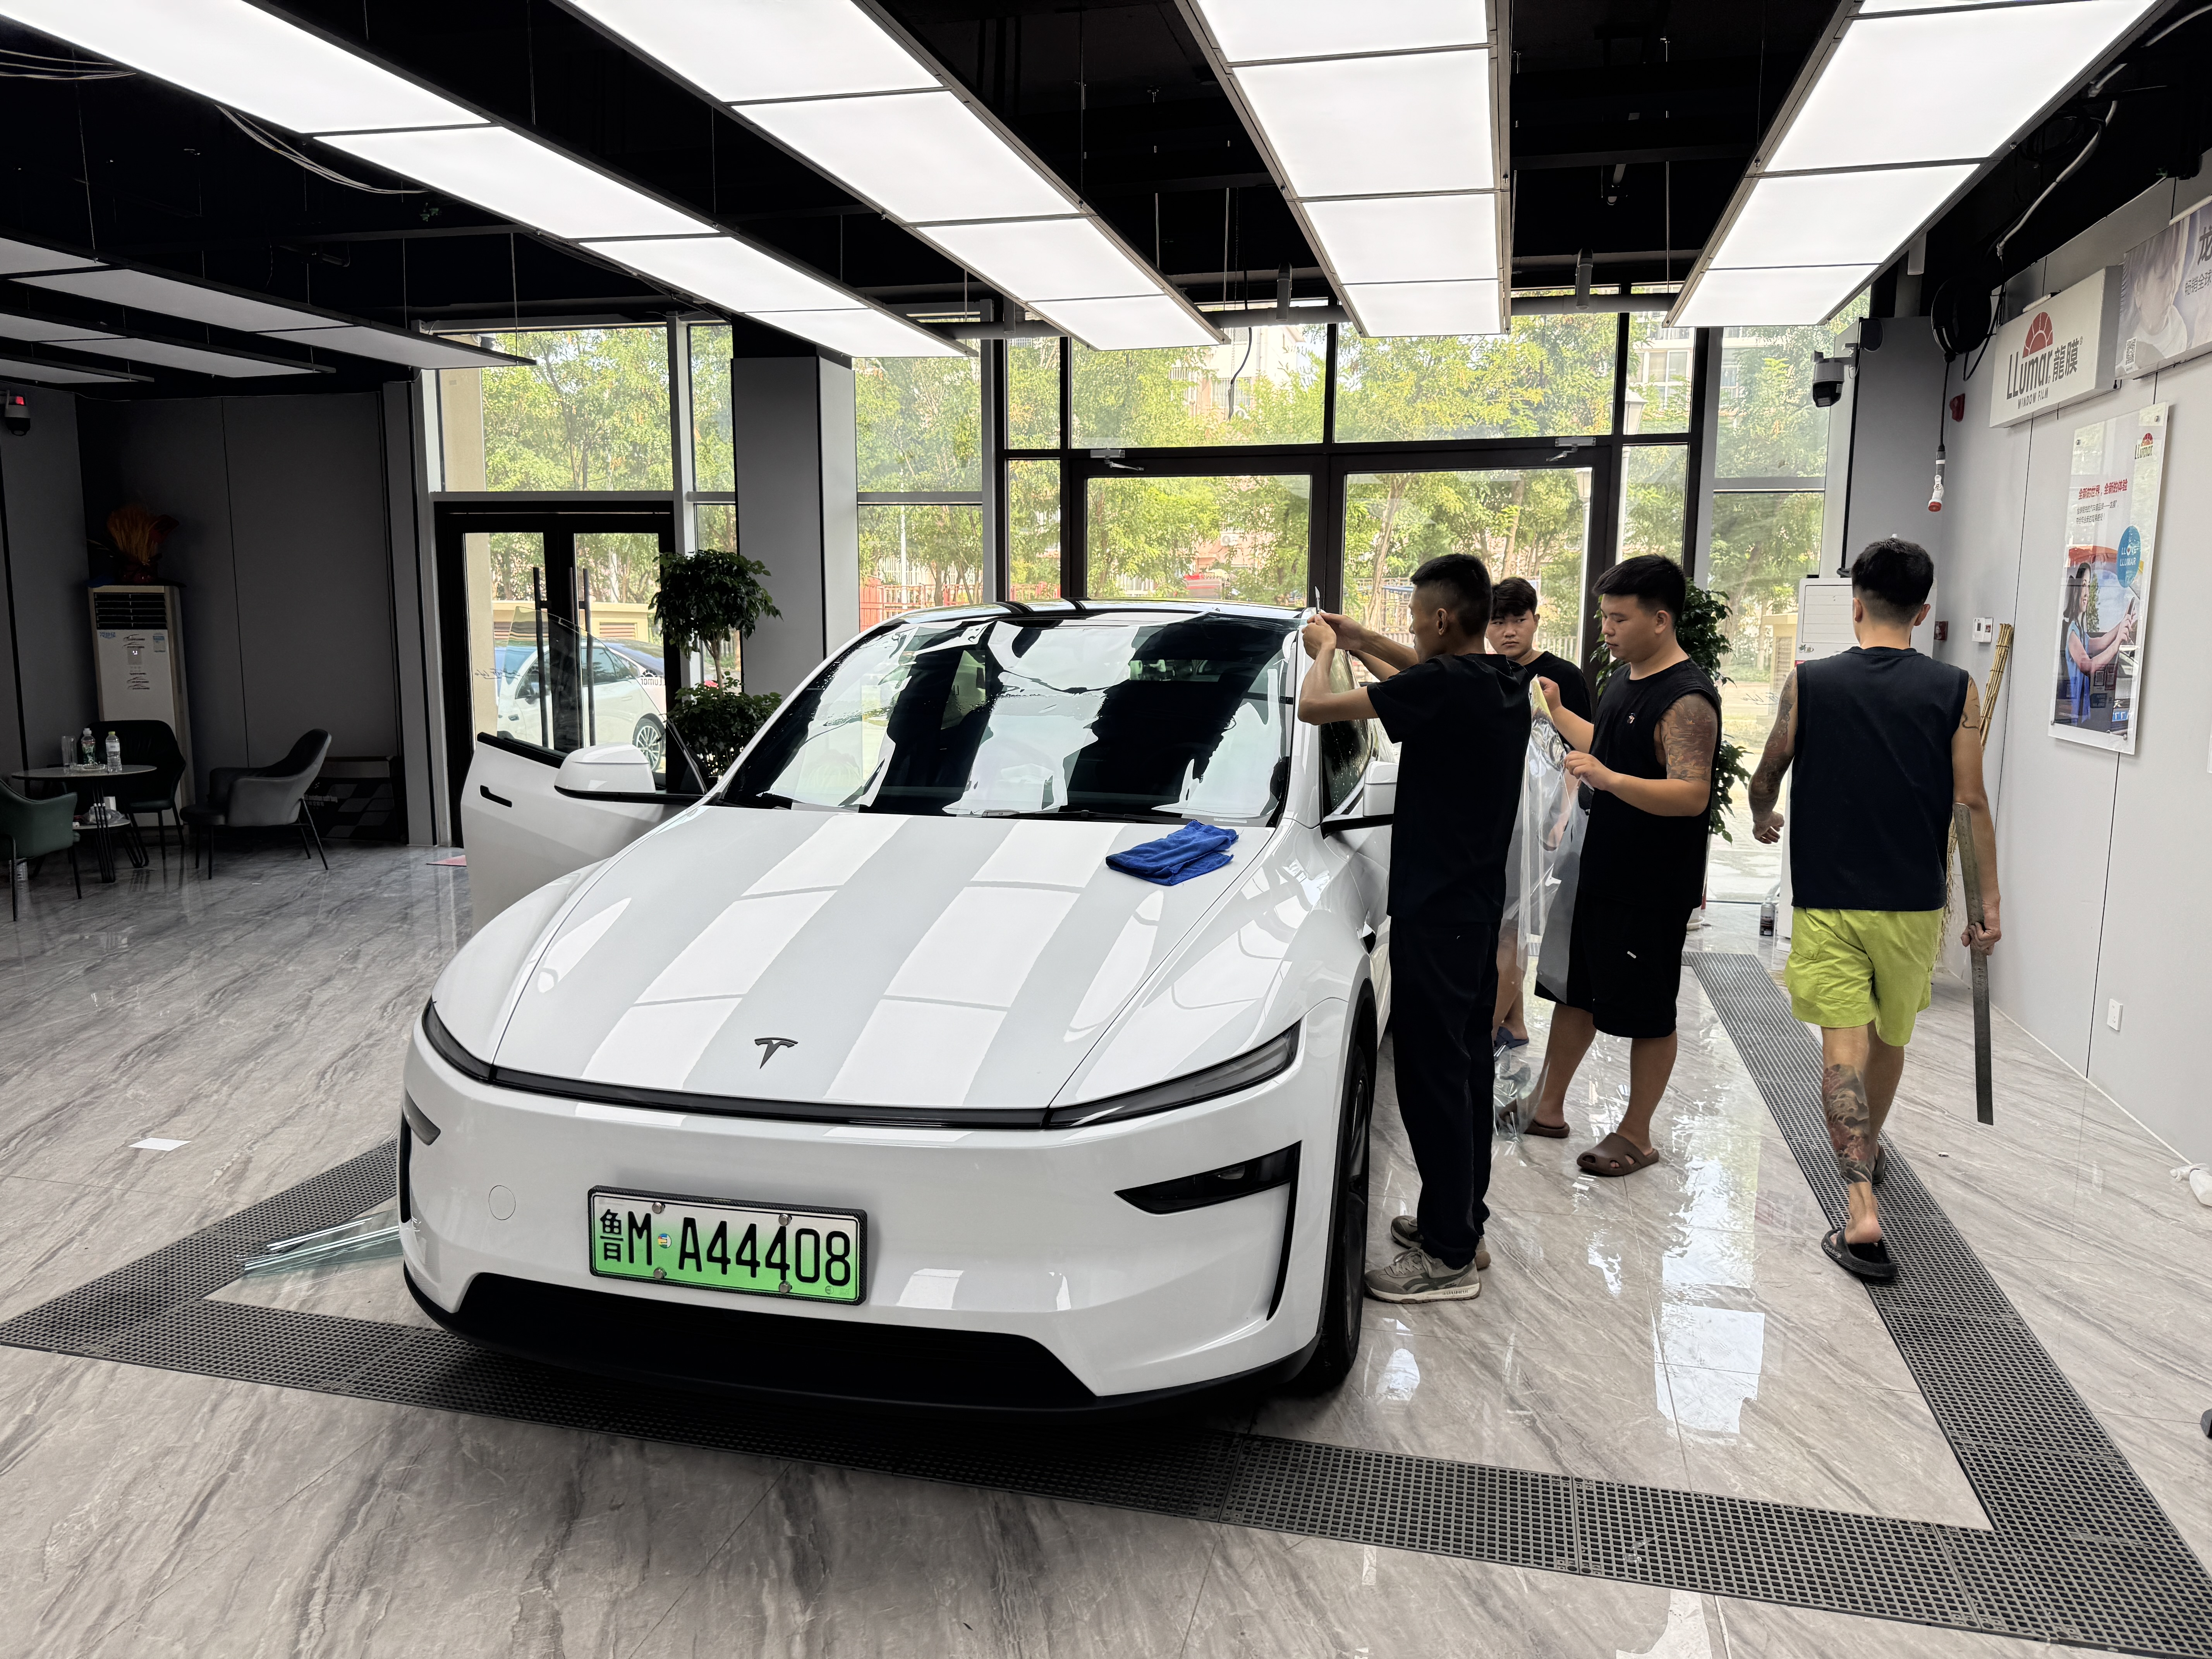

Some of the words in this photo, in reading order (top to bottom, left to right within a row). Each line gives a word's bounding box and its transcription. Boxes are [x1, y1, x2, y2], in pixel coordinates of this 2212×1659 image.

[2006, 349, 2052, 400] LLumar
[2018, 392, 2036, 409] WINDOW
[2038, 387, 2049, 402] FILM
[2135, 444, 2153, 460] LLumar
[2120, 558, 2136, 566] LLUMAR
[678, 1216, 851, 1286] A44408
